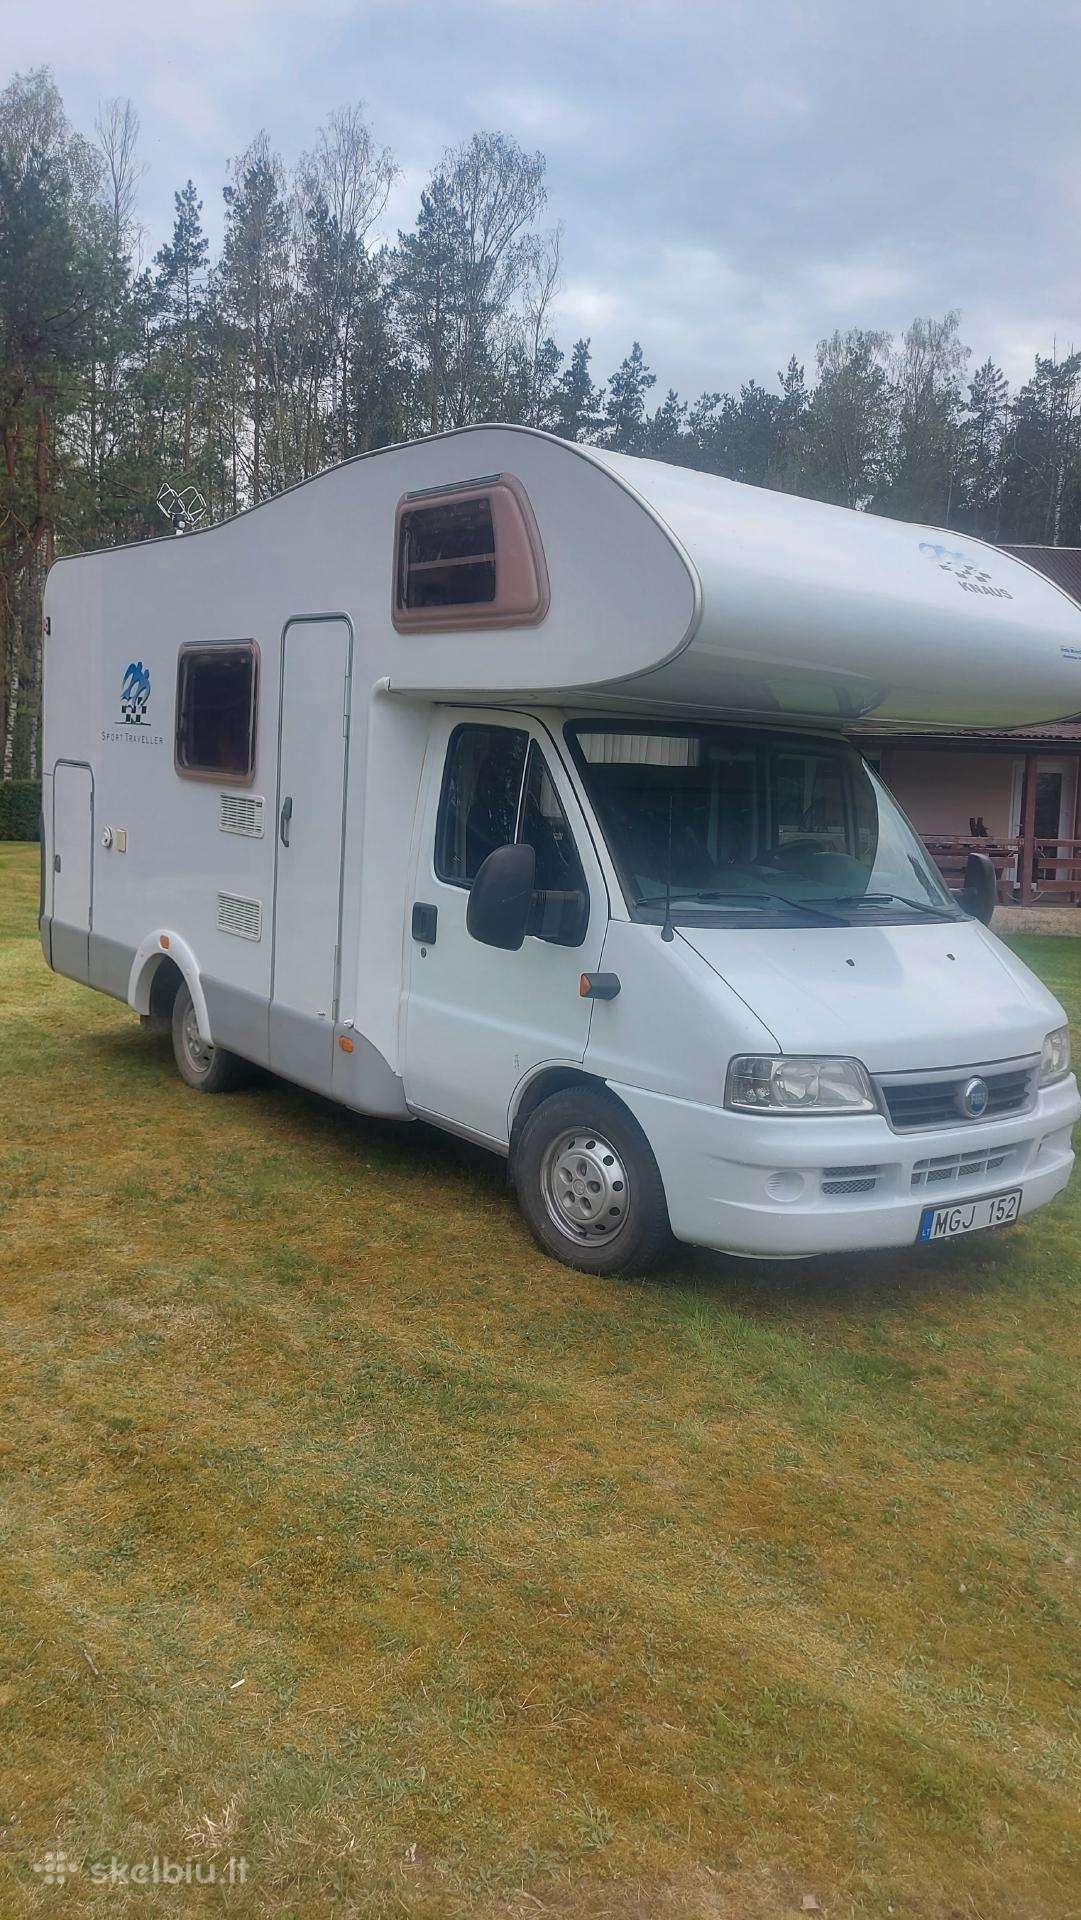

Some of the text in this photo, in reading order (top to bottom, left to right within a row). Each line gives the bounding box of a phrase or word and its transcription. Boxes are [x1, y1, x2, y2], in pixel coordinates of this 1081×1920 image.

[958, 580, 1014, 600] KNAUS
[101, 731, 164, 744] SPORT TRAVELLER
[934, 1196, 1017, 1236] MGJ 152
